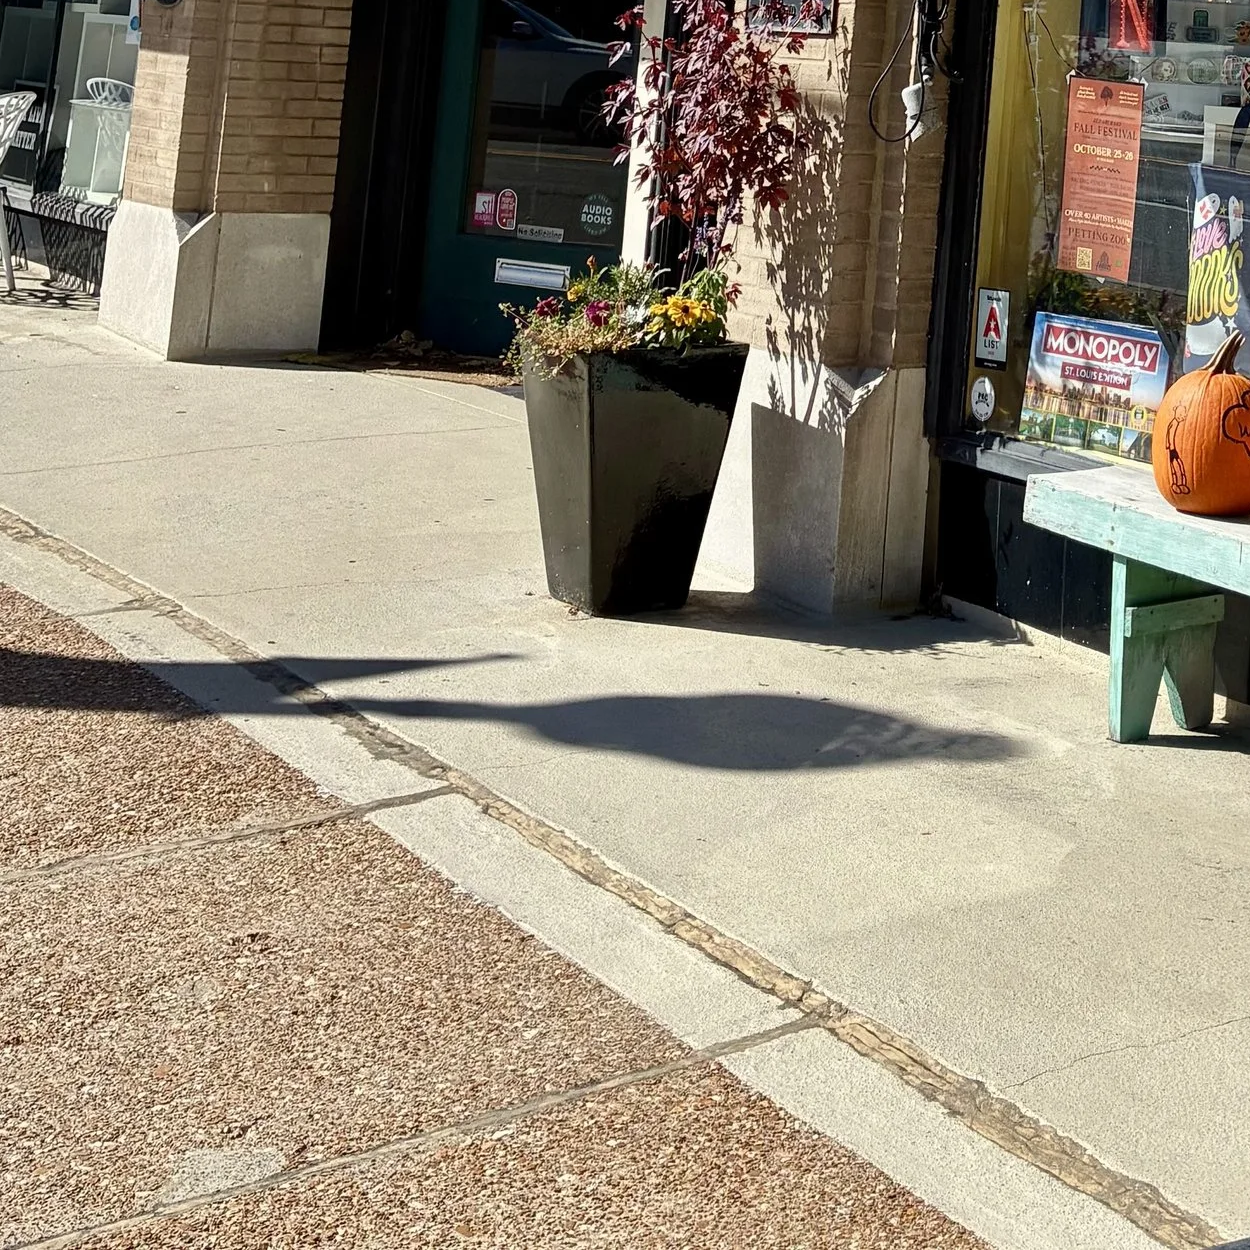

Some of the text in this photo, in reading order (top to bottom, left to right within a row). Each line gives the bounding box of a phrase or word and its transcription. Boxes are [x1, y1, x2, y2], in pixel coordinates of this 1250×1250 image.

[1074, 122, 1096, 135] FALL
[1098, 125, 1137, 141] FESTIVAL
[1073, 143, 1112, 158] OCTOBER
[582, 204, 613, 216] AUDIO
[1064, 209, 1083, 218] OVER
[581, 213, 612, 225] BOOKS
[518, 226, 528, 235] No
[1068, 227, 1108, 242] PETTING
[1110, 234, 1126, 246] ZOO
[984, 338, 999, 350] LIST
[1047, 327, 1157, 368] MONOPOLY
[1064, 366, 1075, 377] ST.
[1076, 367, 1097, 381] LOUIS
